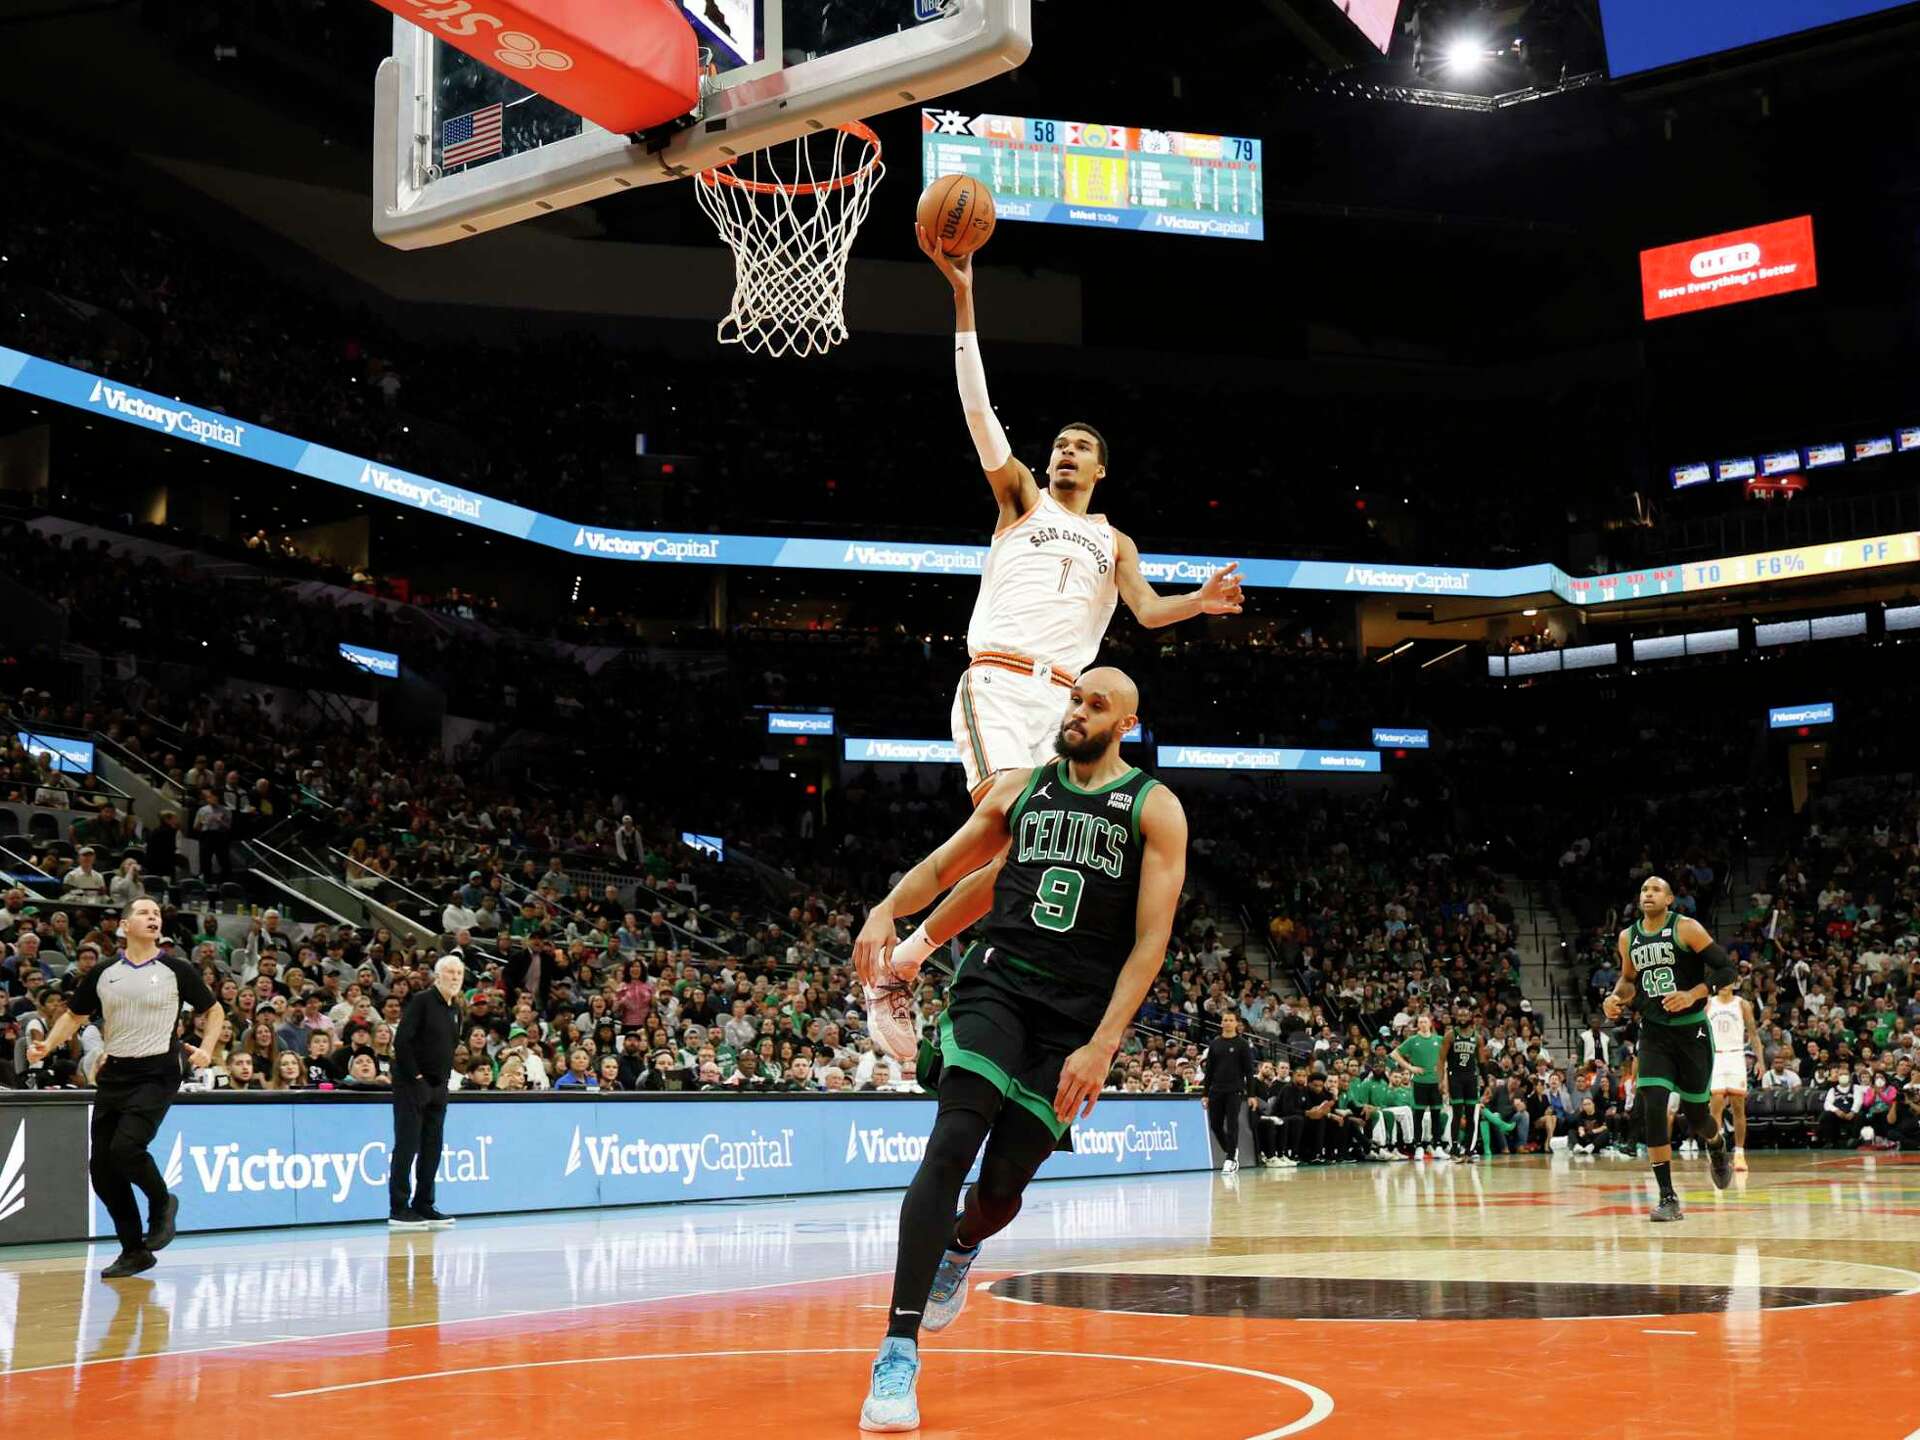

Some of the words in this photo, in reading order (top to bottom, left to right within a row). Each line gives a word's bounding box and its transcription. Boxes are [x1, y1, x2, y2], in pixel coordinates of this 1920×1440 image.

[1034, 121, 1055, 143] 58
[1232, 140, 1253, 162] 79
[941, 190, 970, 240] Wilson
[1164, 213, 1250, 236] VictoryCapital
[103, 385, 245, 447] VictoryCapital
[371, 472, 482, 518] VictoryCapital
[587, 531, 719, 560] VictoryCapital
[855, 546, 985, 571] VictoryCapital
[1030, 527, 1060, 548] SAN
[1062, 529, 1108, 575] ANTONIO
[1058, 556, 1073, 594] 1
[1696, 566, 1721, 584] TO
[1756, 554, 1805, 577] FG%
[1862, 542, 1889, 562] PF
[1355, 571, 1470, 591] VictoryCapital
[1187, 751, 1280, 768] VictoryCapital
[1107, 800, 1132, 812] PRINT
[1110, 791, 1133, 804] VISTA
[1018, 810, 1128, 879] CELTICS
[1031, 866, 1085, 932] 9
[1630, 942, 1676, 971] CELTICS
[1641, 966, 1677, 998] 42
[1718, 1020, 1730, 1033] 10
[584, 1128, 794, 1185] VictoryCapital
